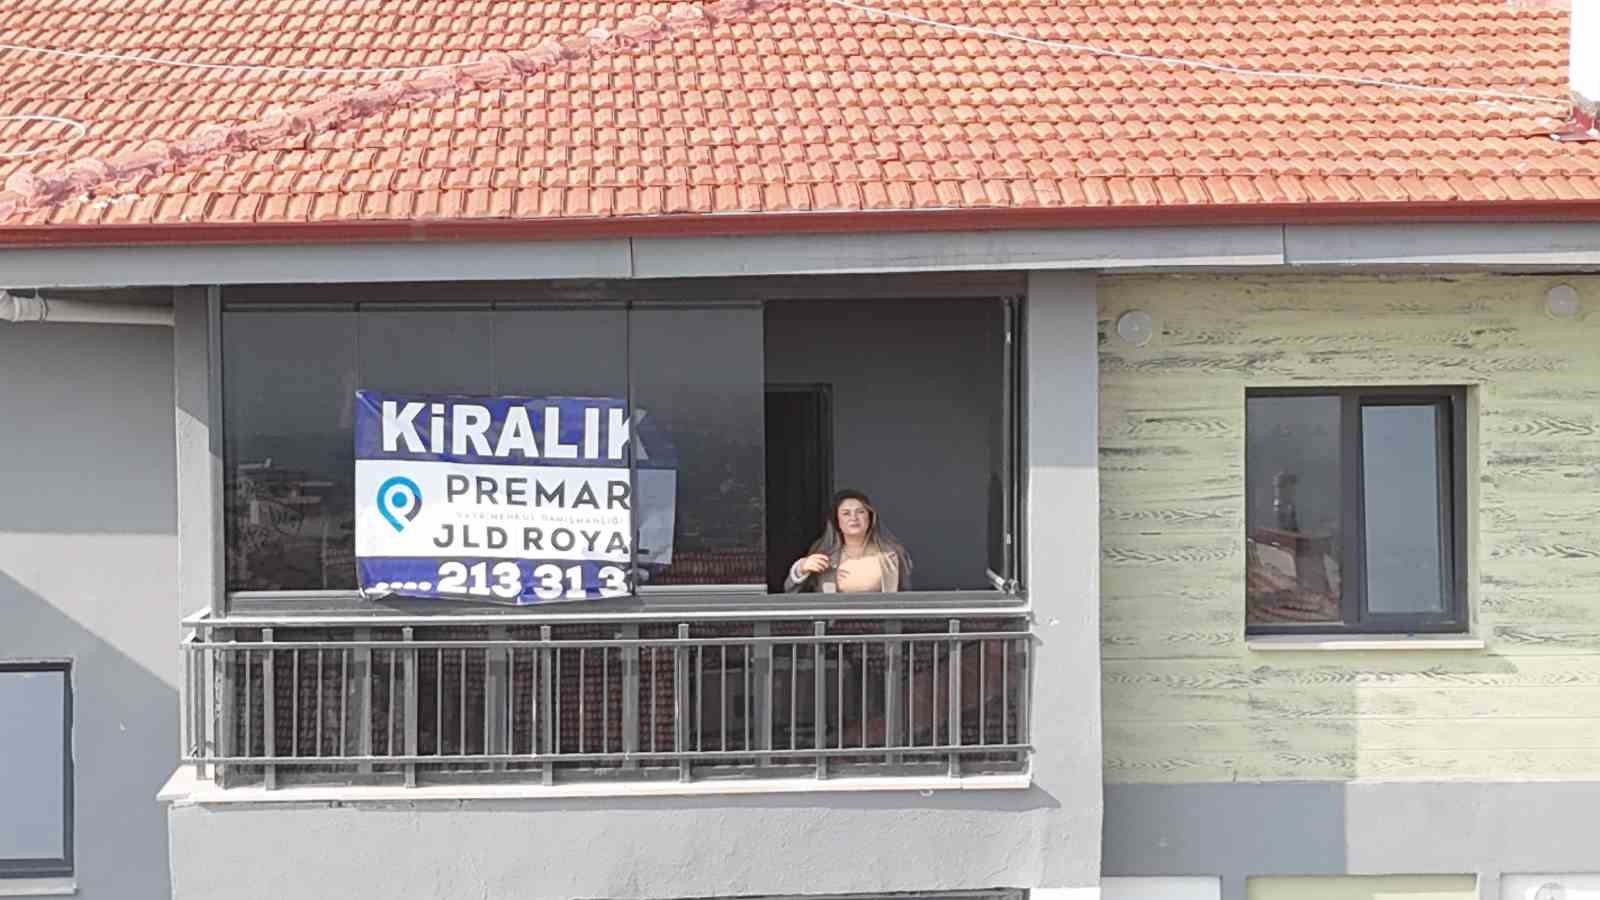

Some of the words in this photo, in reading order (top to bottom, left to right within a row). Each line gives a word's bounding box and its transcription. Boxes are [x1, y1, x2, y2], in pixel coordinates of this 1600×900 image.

[446, 474, 632, 511] PREMAR
[432, 523, 508, 550] JLD
[437, 561, 522, 599] 213
[533, 563, 586, 600] 31
